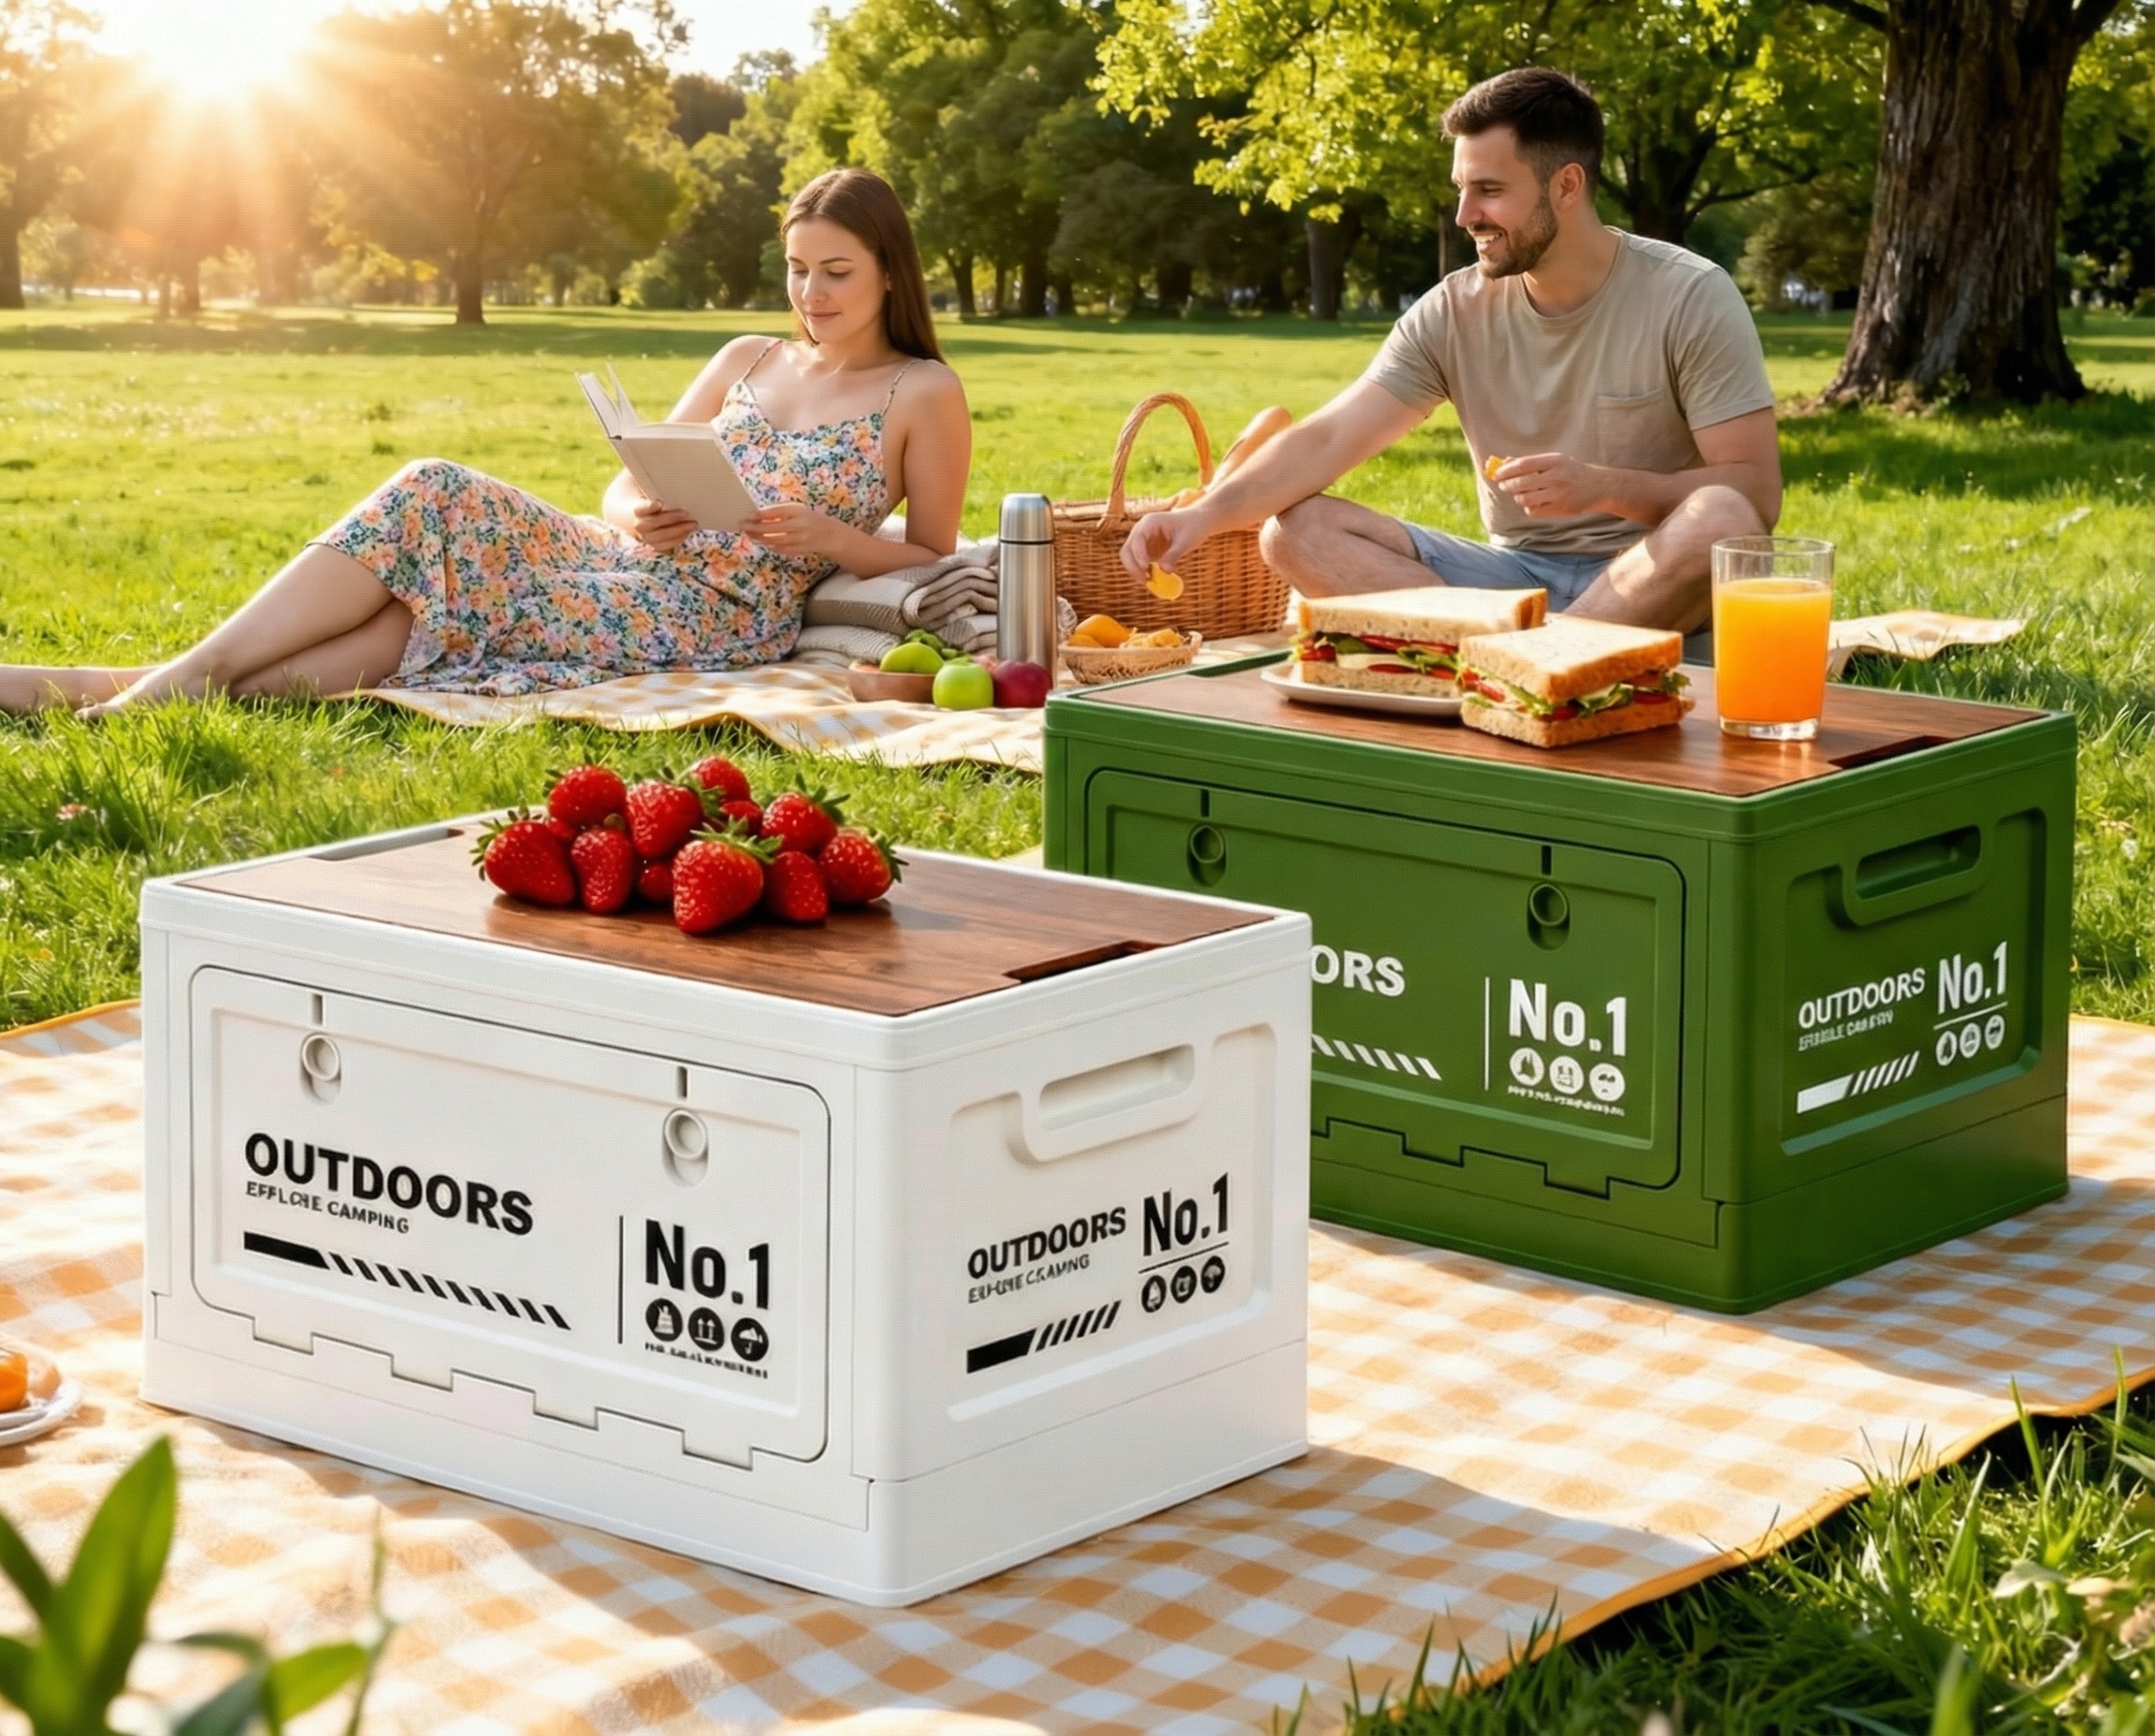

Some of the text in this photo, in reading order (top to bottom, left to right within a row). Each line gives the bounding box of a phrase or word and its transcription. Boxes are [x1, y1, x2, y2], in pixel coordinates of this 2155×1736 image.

[1798, 967, 1926, 1029] OUTDOORS
[1938, 941, 2007, 1015] No.1
[1509, 978, 1627, 1057] No.1
[244, 1133, 533, 1236] OUTDOORS
[326, 1200, 410, 1235] CAMPING
[1143, 1172, 1228, 1257] No.1
[645, 1219, 770, 1310] No.1
[967, 1206, 1126, 1280] OUTDOORS
